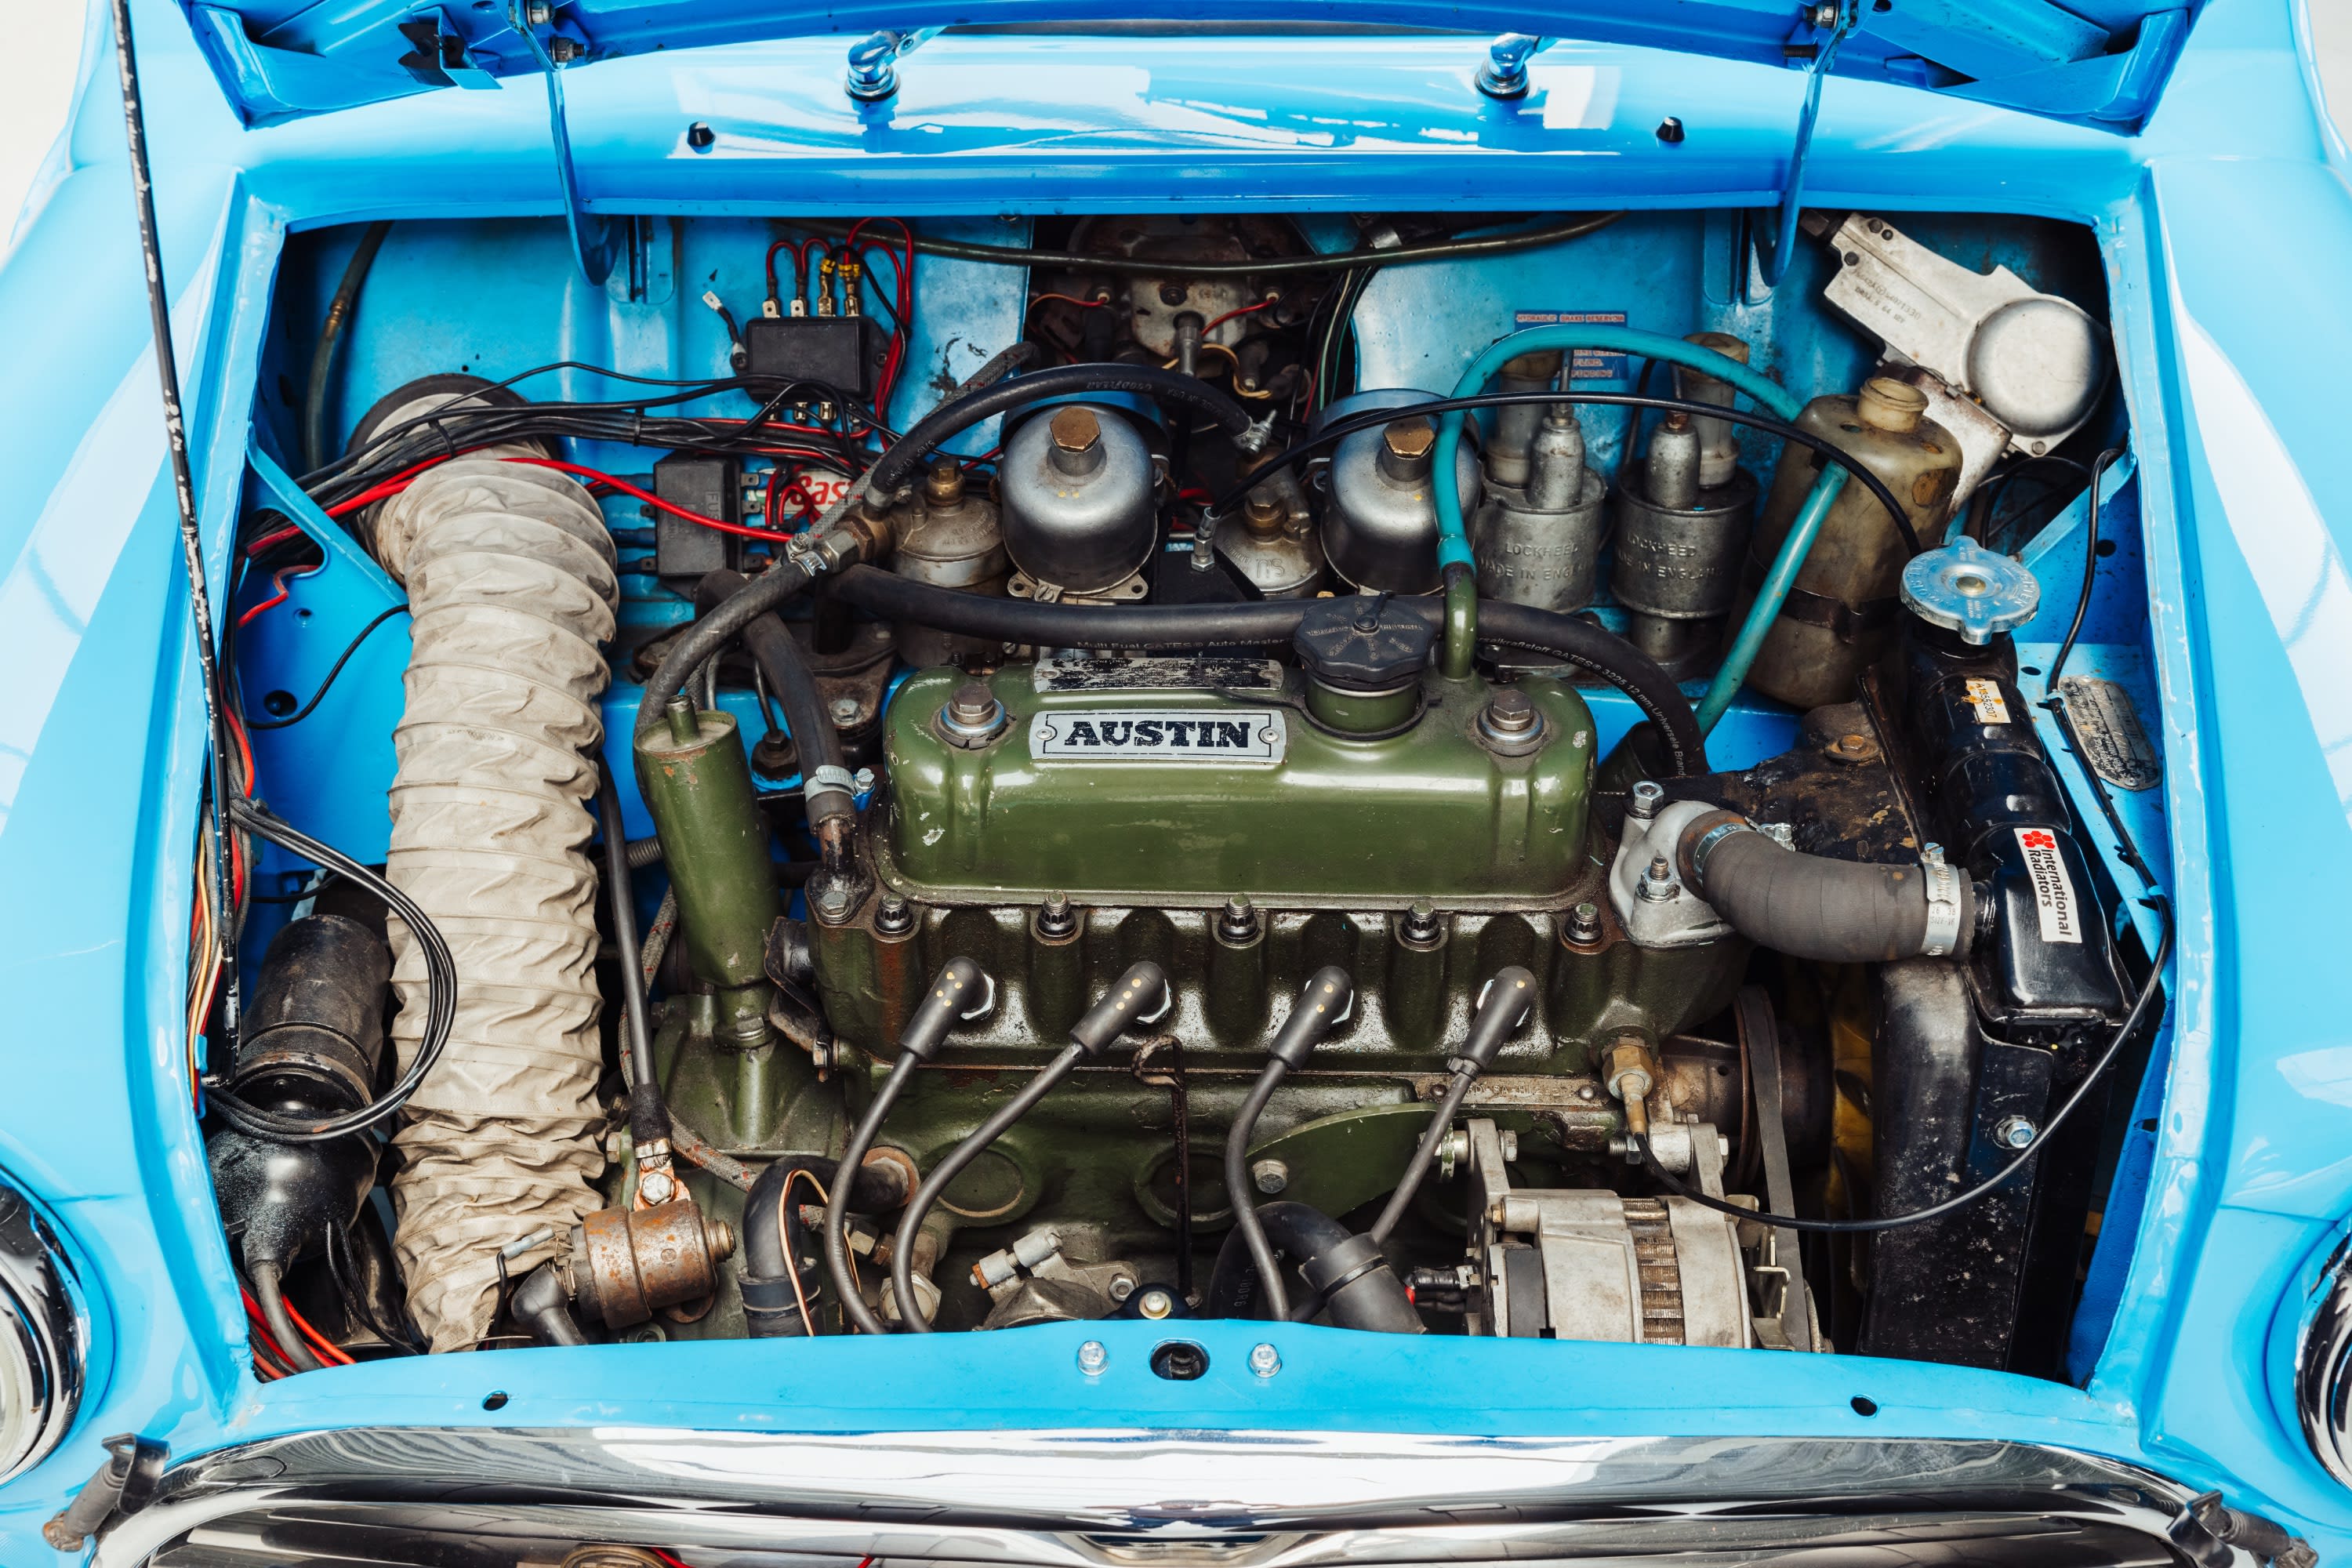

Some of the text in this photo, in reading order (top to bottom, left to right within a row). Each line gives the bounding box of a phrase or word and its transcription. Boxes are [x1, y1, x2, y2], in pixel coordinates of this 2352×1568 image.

[1516, 314, 1625, 323] HYDRAULIC BRAKE RESERVOIR
[1505, 541, 1579, 558] LOCKHEED
[1627, 531, 1697, 558] LOCKHEED
[1520, 567, 1536, 580] IN
[1076, 641, 1108, 649] Multi
[1602, 668, 1628, 686] 3225
[1627, 684, 1640, 695] 12
[1637, 693, 1653, 709] mm
[1064, 720, 1250, 748] AUSTIN
[2027, 849, 2053, 908] Radiators
[2041, 848, 2073, 936] International
